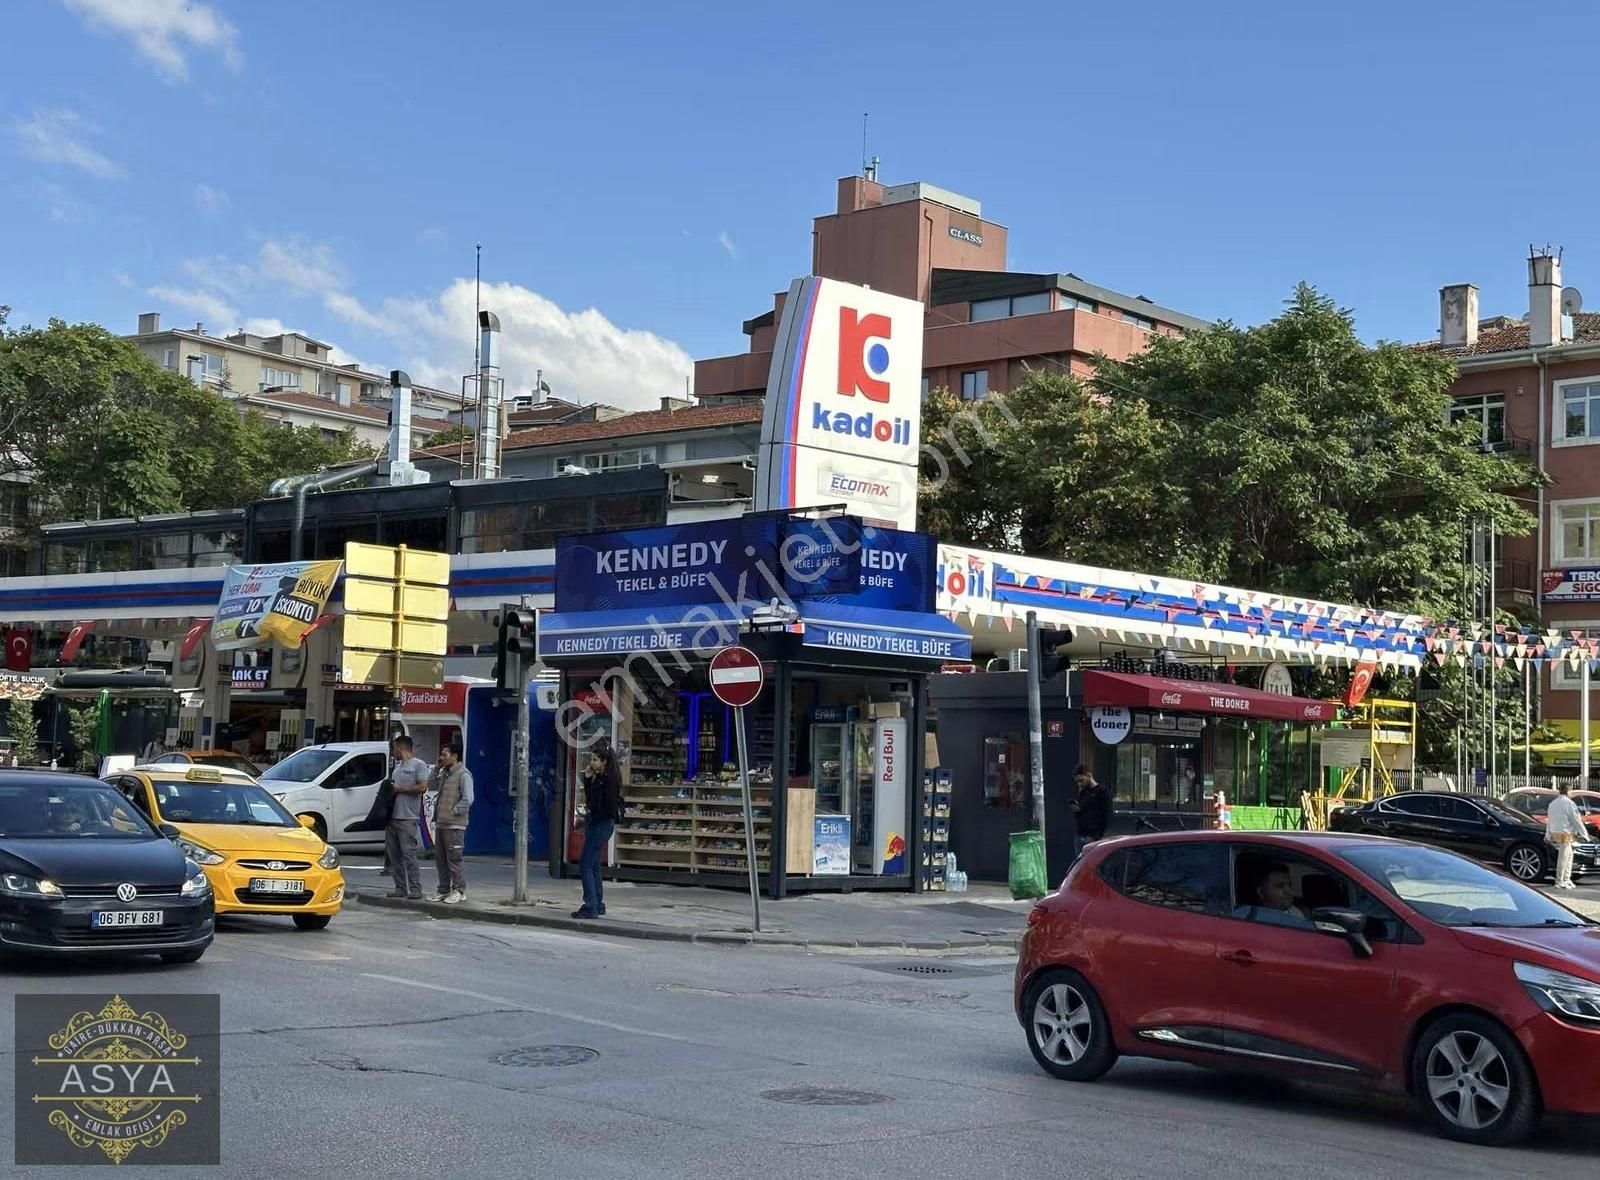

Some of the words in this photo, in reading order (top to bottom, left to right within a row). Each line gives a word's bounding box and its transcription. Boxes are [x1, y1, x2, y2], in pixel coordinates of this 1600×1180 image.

[950, 228, 982, 244] CLASS
[812, 402, 910, 445] kadoil
[797, 543, 839, 555] KENNEDY
[596, 539, 728, 575] KENNEDY
[616, 578, 656, 593] TEKEL
[658, 576, 667, 589] &
[671, 571, 706, 588] BÜFE
[868, 574, 894, 588] BÜFE
[296, 577, 330, 601] BÜYÜK
[557, 637, 610, 653] KENNEDY
[611, 635, 647, 650] TEKEL
[650, 633, 682, 648] BÜFE
[827, 631, 883, 650] KENNEDY
[885, 637, 920, 653] TEKEL
[922, 638, 951, 655] BÜFE
[21, 675, 45, 683] SUCUK
[255, 669, 269, 681] ET
[407, 692, 424, 704] Ziraat
[1210, 696, 1224, 708] THE
[1102, 706, 1121, 716] the
[1050, 723, 1059, 732] 47
[1094, 718, 1129, 730] doner
[883, 729, 893, 754] Bull
[883, 756, 893, 782] Red
[256, 880, 265, 889] 06
[271, 880, 276, 889] T
[284, 880, 303, 890] 3181
[100, 912, 113, 925] 06
[118, 912, 137, 925] BFV
[142, 912, 161, 924] 681
